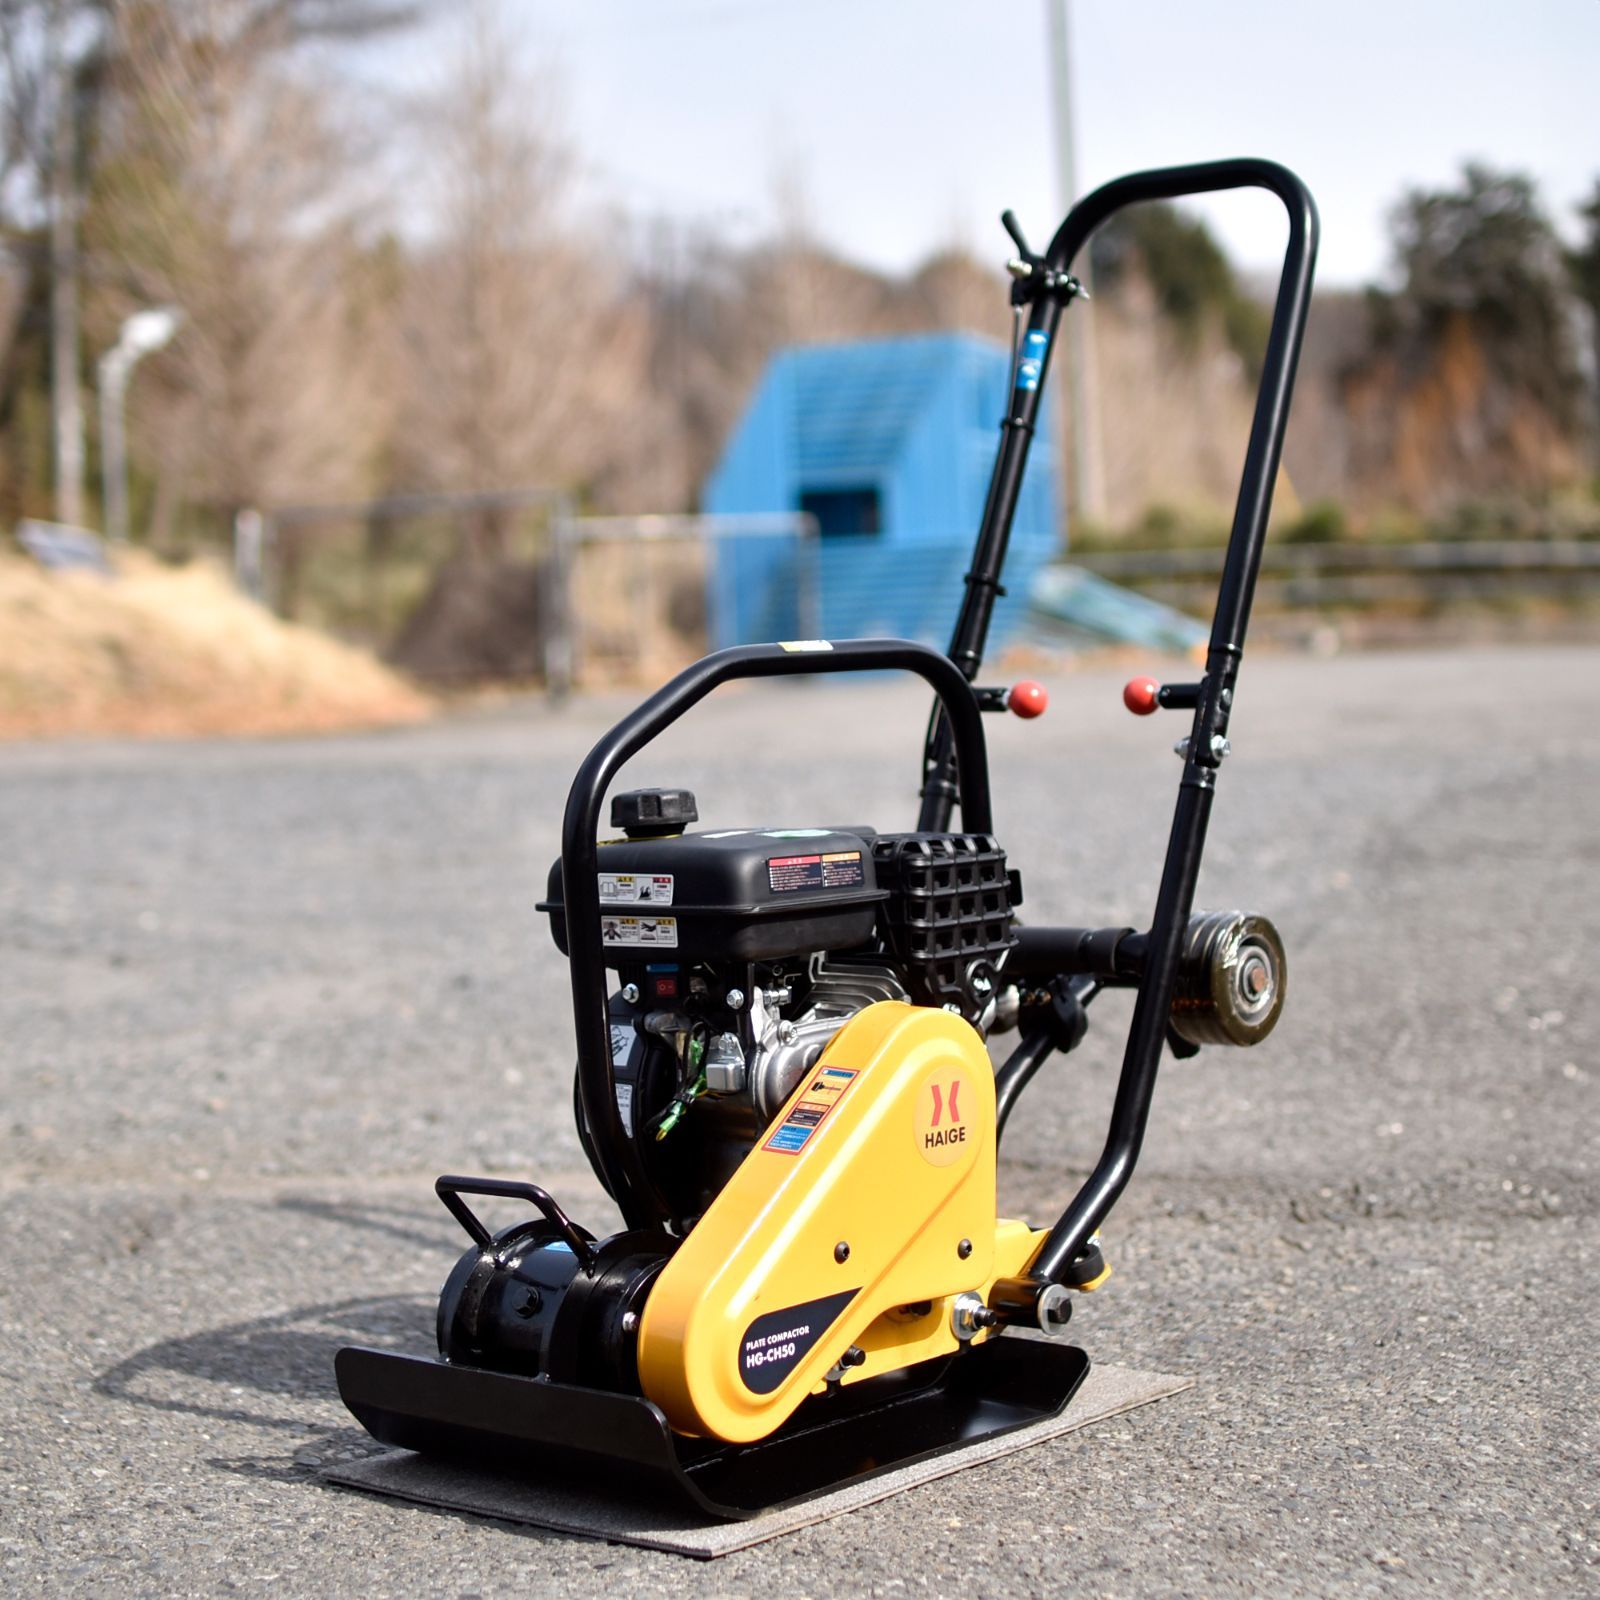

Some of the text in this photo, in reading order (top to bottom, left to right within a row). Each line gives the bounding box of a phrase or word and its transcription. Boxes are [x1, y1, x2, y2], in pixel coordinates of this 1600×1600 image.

[925, 1126, 966, 1149] HAIGE
[746, 1325, 810, 1351] PLATE COMPACTOR
[746, 1342, 796, 1369] HG-CH50
